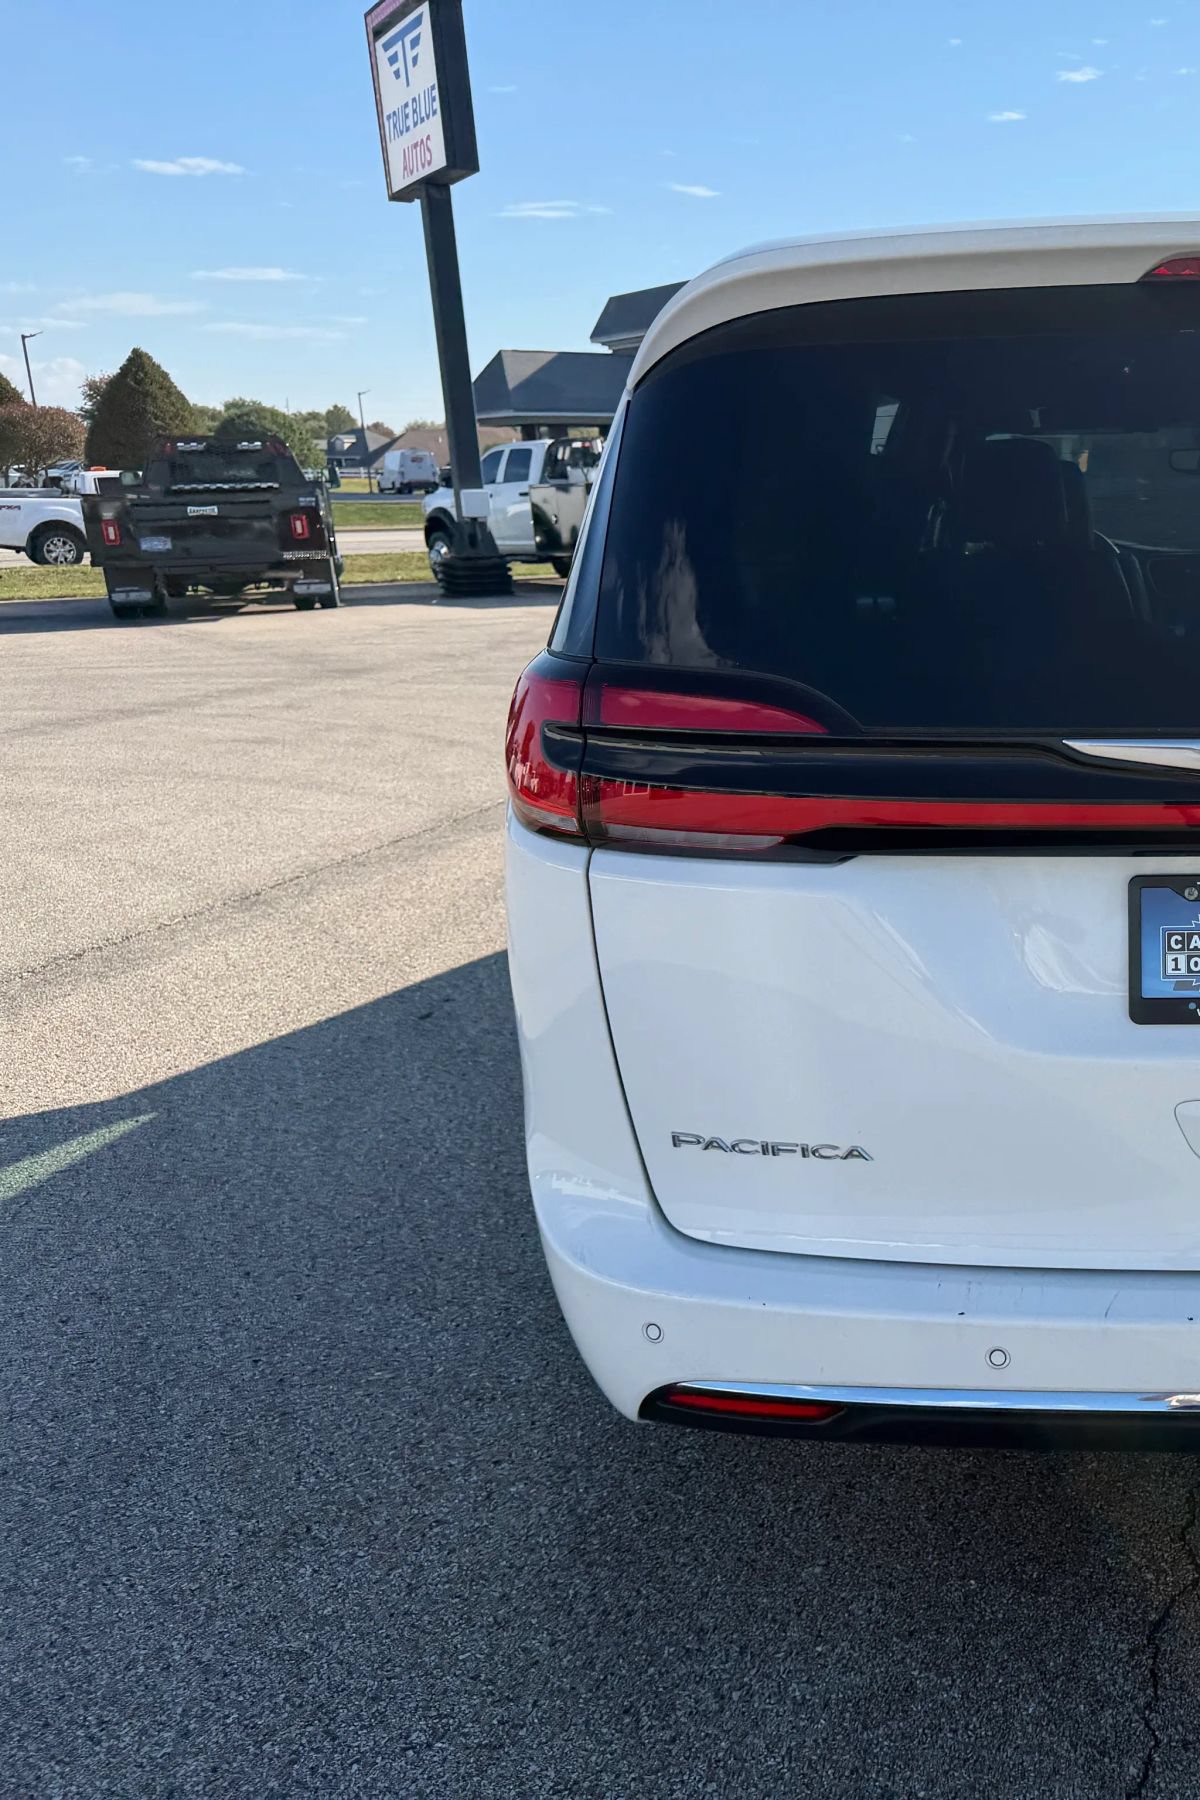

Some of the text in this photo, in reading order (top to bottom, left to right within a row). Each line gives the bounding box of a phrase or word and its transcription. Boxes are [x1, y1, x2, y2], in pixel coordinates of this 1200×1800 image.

[386, 84, 437, 143] TRUE BLUE
[403, 134, 432, 178] AUTOS
[671, 1131, 874, 1161] PACIFICA
